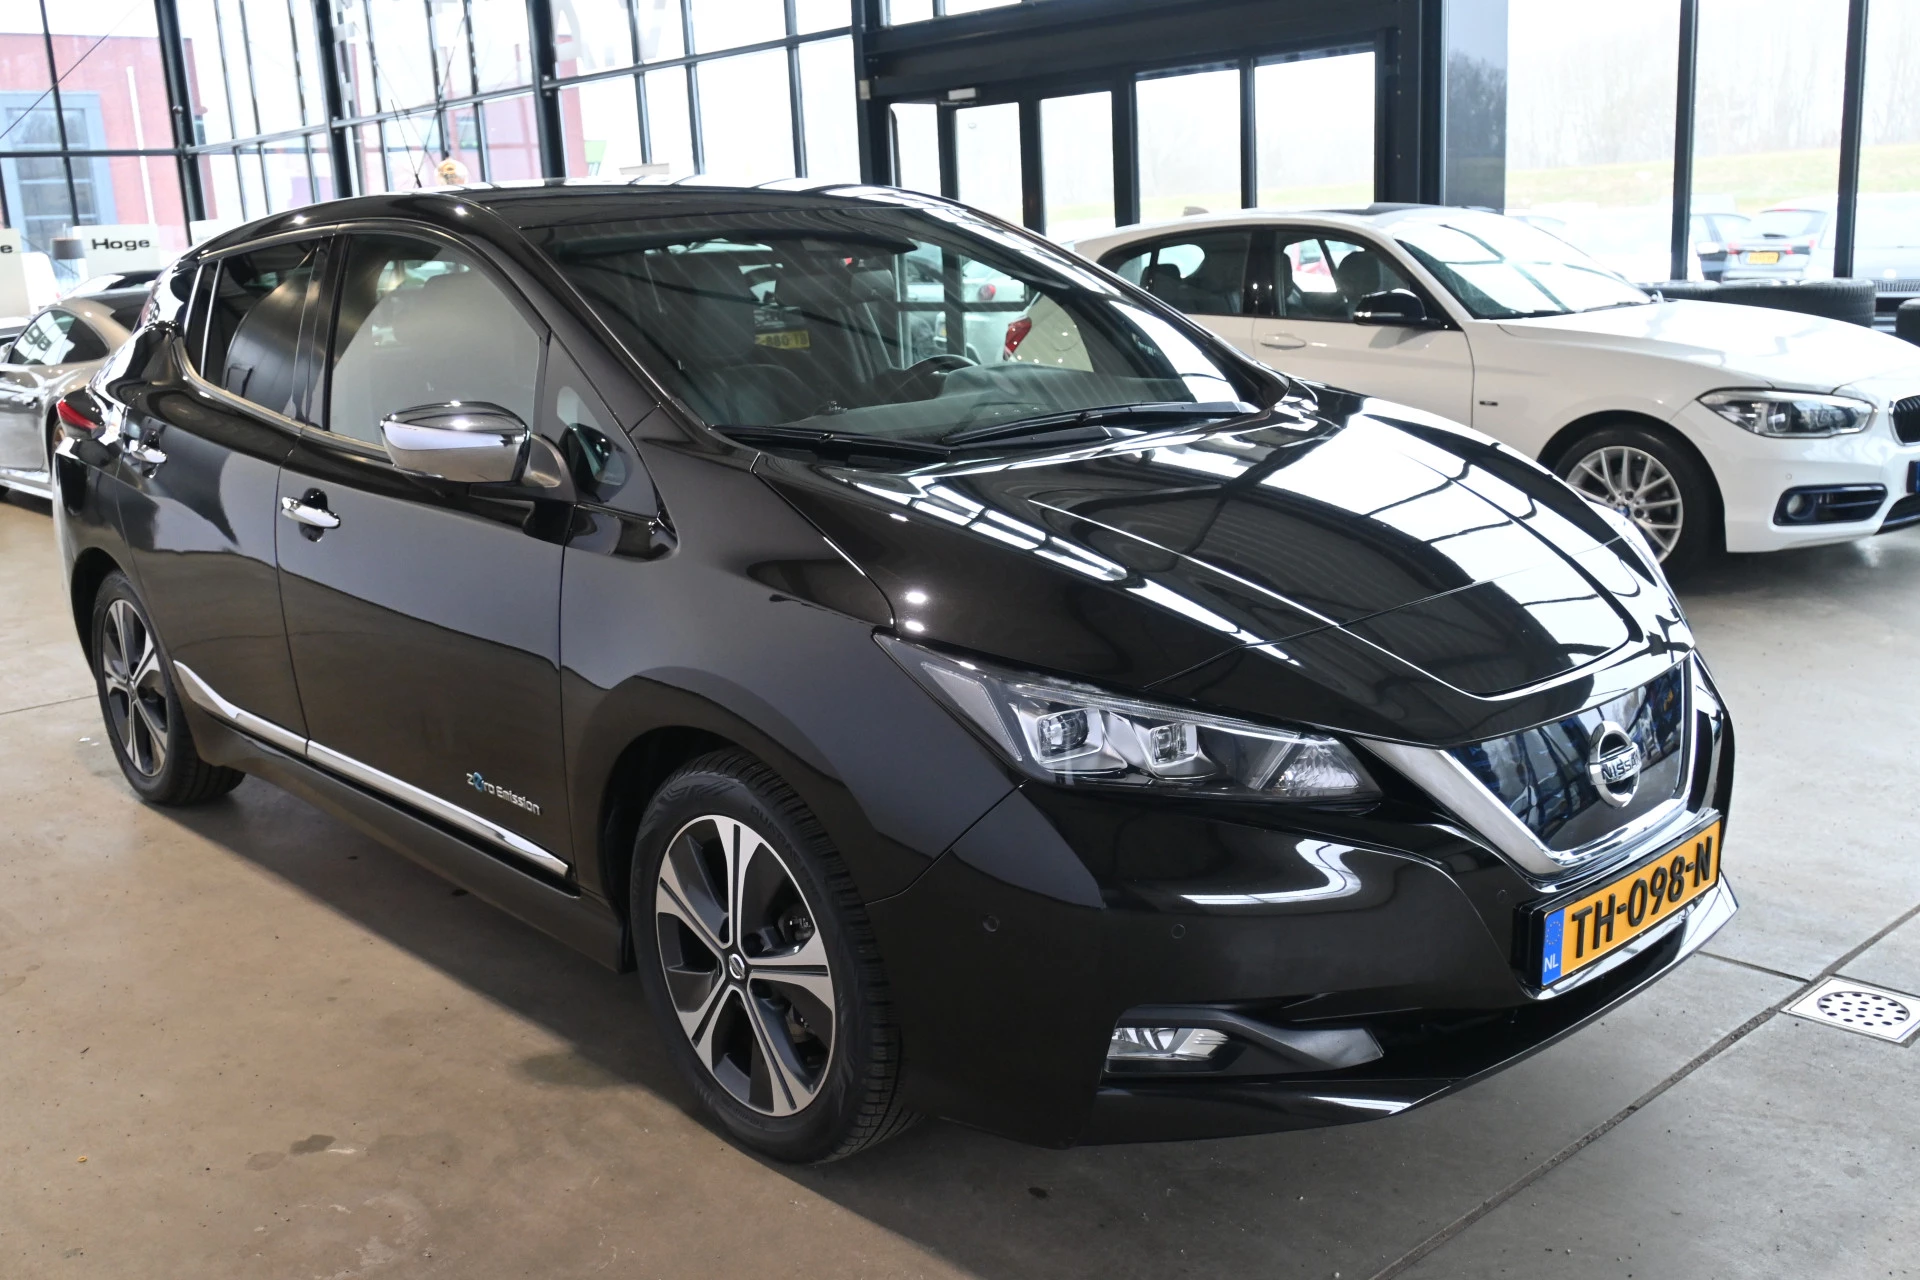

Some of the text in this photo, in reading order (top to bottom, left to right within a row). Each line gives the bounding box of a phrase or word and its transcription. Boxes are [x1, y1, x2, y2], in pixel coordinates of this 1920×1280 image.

[91, 238, 150, 251] Hoge
[1601, 751, 1641, 780] NISSA
[496, 785, 540, 816] Emission
[1571, 834, 1713, 959] TH-098-N
[1544, 953, 1559, 973] NL
